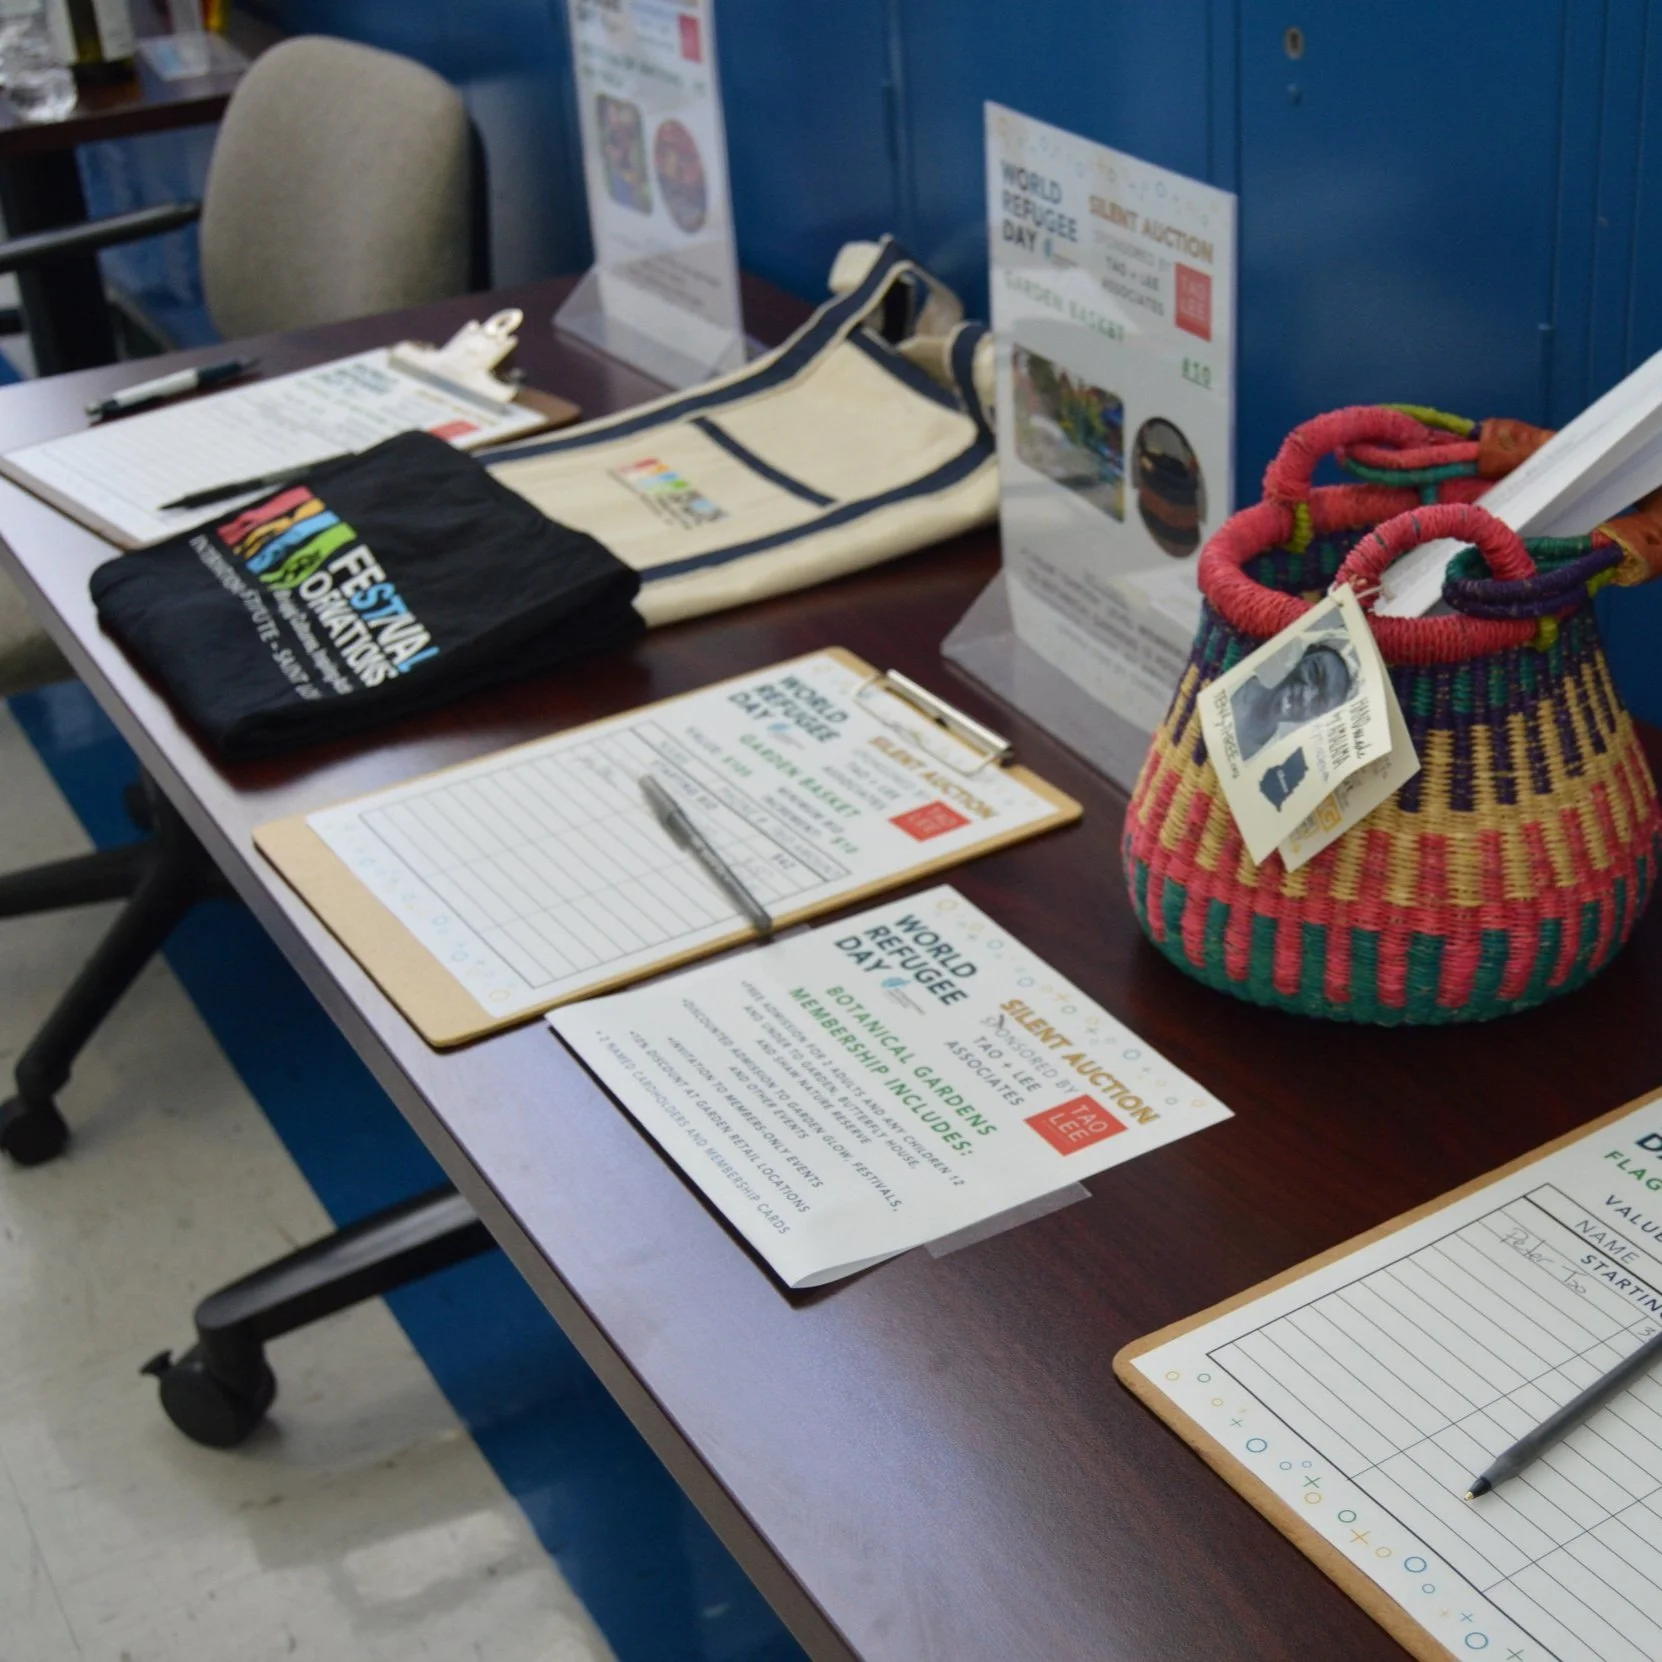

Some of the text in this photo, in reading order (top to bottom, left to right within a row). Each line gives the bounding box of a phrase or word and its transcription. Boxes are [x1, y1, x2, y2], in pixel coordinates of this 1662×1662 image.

[1000, 160, 1062, 205] WORLD
[1001, 190, 1078, 243] REFUGEE
[1002, 219, 1038, 253] DAY
[1141, 219, 1215, 264] AUCTION
[328, 544, 440, 673] FESTIVAL
[728, 692, 774, 720] DAY
[754, 684, 841, 743] REFUGEE
[780, 676, 848, 723] WORLD
[739, 733, 799, 777] GARDEN
[798, 777, 861, 818] BASKET
[867, 735, 998, 820] SILENT AUCTION
[834, 936, 892, 972] DAY
[864, 925, 969, 1006] REFUGEE
[894, 914, 977, 978] WORLD
[743, 1004, 764, 1023] AND
[761, 1022, 792, 1049] UNDER
[788, 1048, 805, 1061] TO
[837, 1095, 889, 1139] BUTTERFLY
[756, 1038, 873, 1145] AND SHAW NATURE RESERVE
[789, 987, 974, 1157] MEMBERSHIP INCLUDES:
[826, 985, 998, 1137] BOTANICAL GARDENS
[944, 1039, 1025, 1107] ASSOCIATES
[973, 1034, 1004, 1060] TAO
[1011, 1069, 1043, 1093] LEE
[980, 1014, 1080, 1095] SPONSORED BY
[1000, 998, 1074, 1050] SILENT
[1061, 1052, 1161, 1125] AUCTION
[606, 1042, 638, 1071] NAMED
[631, 1070, 691, 1129] CARDHOLDERS
[685, 1127, 709, 1148] AND
[704, 1146, 762, 1202] MEMBERSHIP
[756, 1202, 792, 1236] CARDS
[645, 1049, 690, 1088] DISCOUNT
[684, 1088, 701, 1100] AT
[695, 1099, 733, 1134] GARDEN
[728, 1133, 762, 1163] RETAIL
[756, 1162, 812, 1214] LOCATIONS
[711, 1080, 729, 1094] TO
[724, 1093, 792, 1155] MEMBERS-ONLY
[785, 1155, 825, 1189] EVENTS
[728, 1065, 811, 1140] AND OTHER EVENTS
[731, 1047, 777, 1090] ADMISSION
[774, 1088, 791, 1101] TO
[786, 1101, 827, 1135] GARDEN
[821, 1134, 854, 1163] GLOW,
[851, 1160, 903, 1212] FESTIVALS,
[805, 1043, 827, 1060] FOR
[831, 1067, 867, 1097] ADULTS
[864, 1097, 885, 1117] AND
[882, 1116, 907, 1134] ANY
[903, 1134, 952, 1175] CHILDREN
[949, 1174, 966, 1187] 12
[1049, 1111, 1091, 1143] LEE
[1071, 1103, 1109, 1133] TAO
[1575, 1219, 1641, 1266] NAME
[1580, 1254, 1662, 1319] STARTIN
